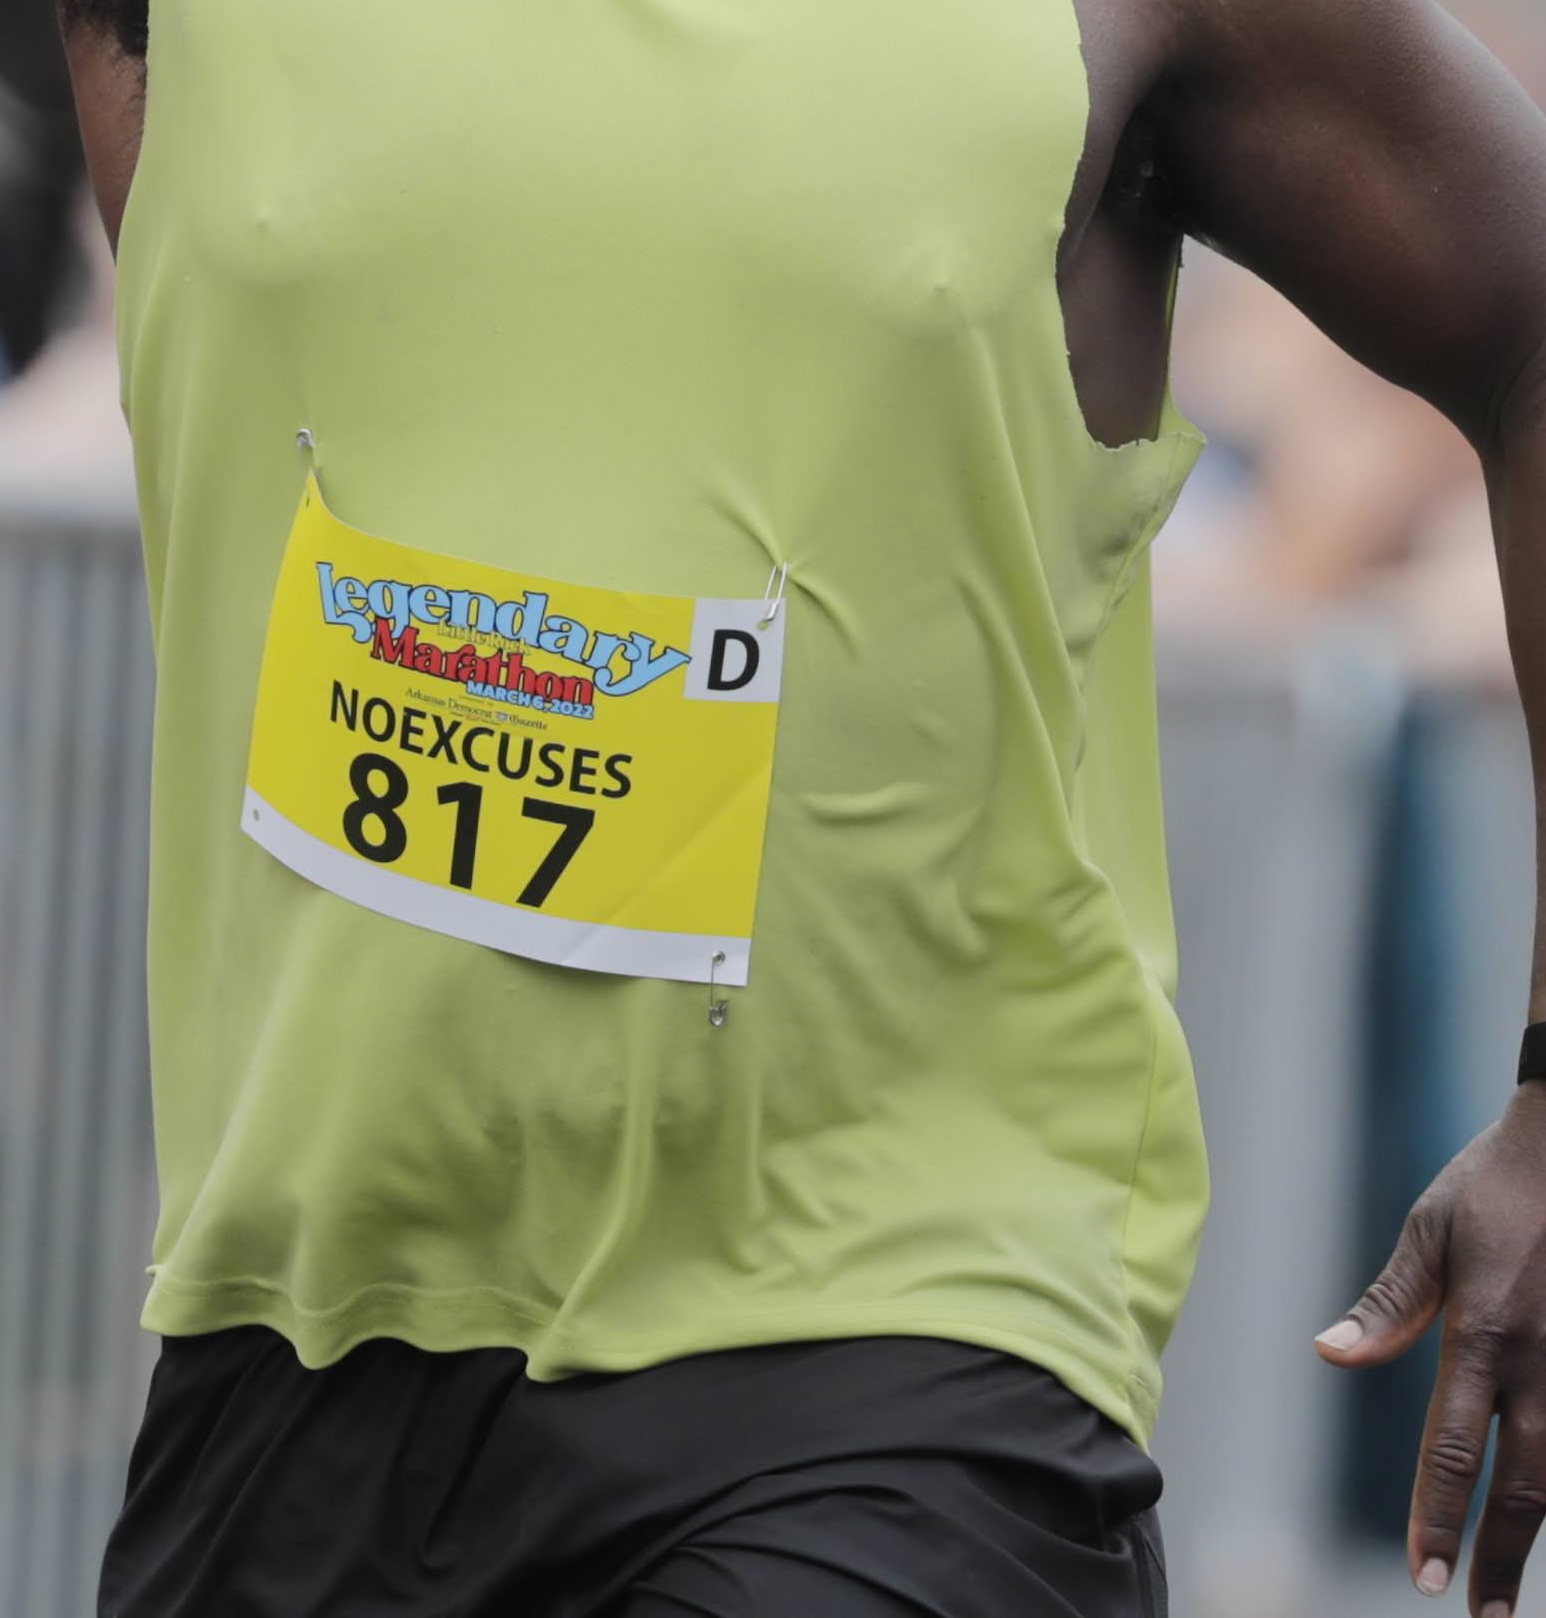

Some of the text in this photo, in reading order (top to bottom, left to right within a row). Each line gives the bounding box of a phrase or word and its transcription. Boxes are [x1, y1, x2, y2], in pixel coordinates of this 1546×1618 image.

[369, 616, 595, 706] Marathon
[466, 680, 532, 708] MARCH
[550, 698, 595, 720] 2022
[705, 628, 760, 691] D
[330, 680, 633, 799] NOEXCUSES
[341, 752, 596, 908] 817
